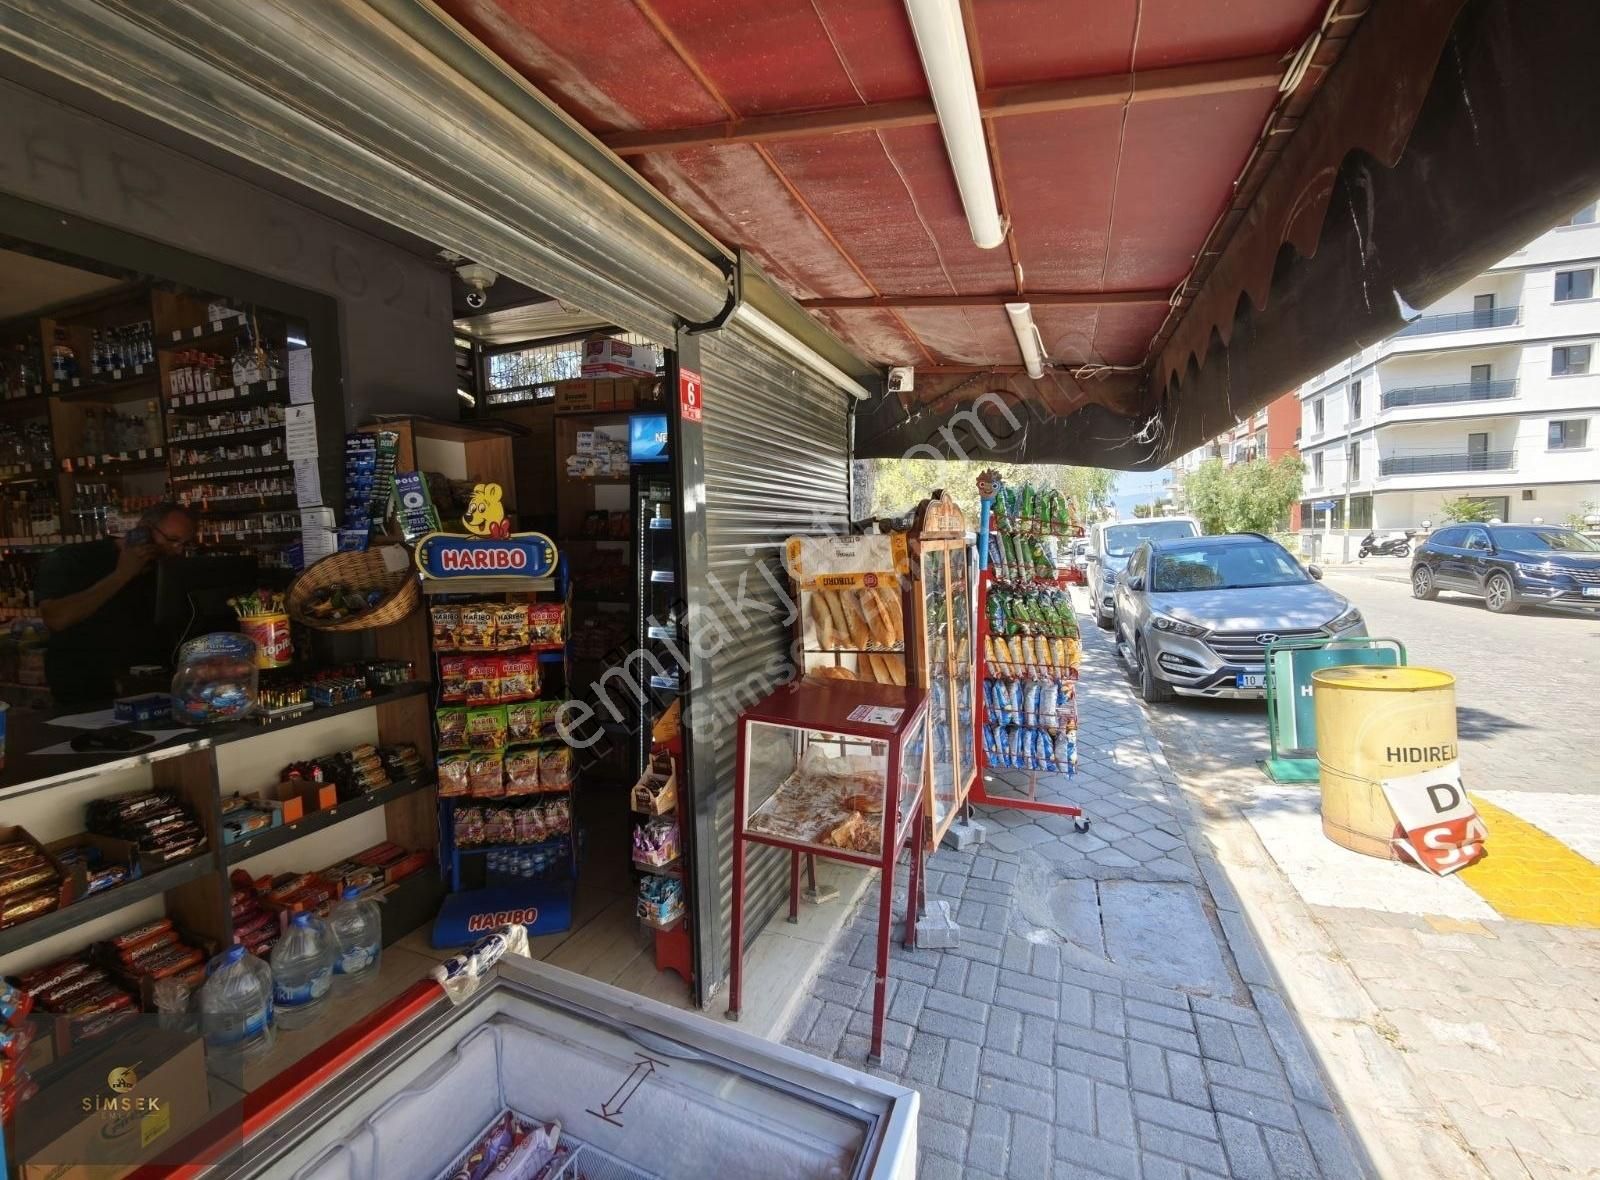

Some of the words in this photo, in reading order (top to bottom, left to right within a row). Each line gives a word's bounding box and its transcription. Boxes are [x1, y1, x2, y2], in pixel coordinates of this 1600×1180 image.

[687, 382, 696, 406] 6
[395, 476, 420, 485] POLO
[441, 548, 527, 570] HARIBO
[823, 576, 855, 586] TUBORG
[463, 613, 491, 622] HARIBO
[498, 613, 525, 622] HARIBO
[1245, 676, 1256, 686] 10
[1387, 745, 1458, 763] HIDIREL
[468, 908, 538, 932] HARIBO
